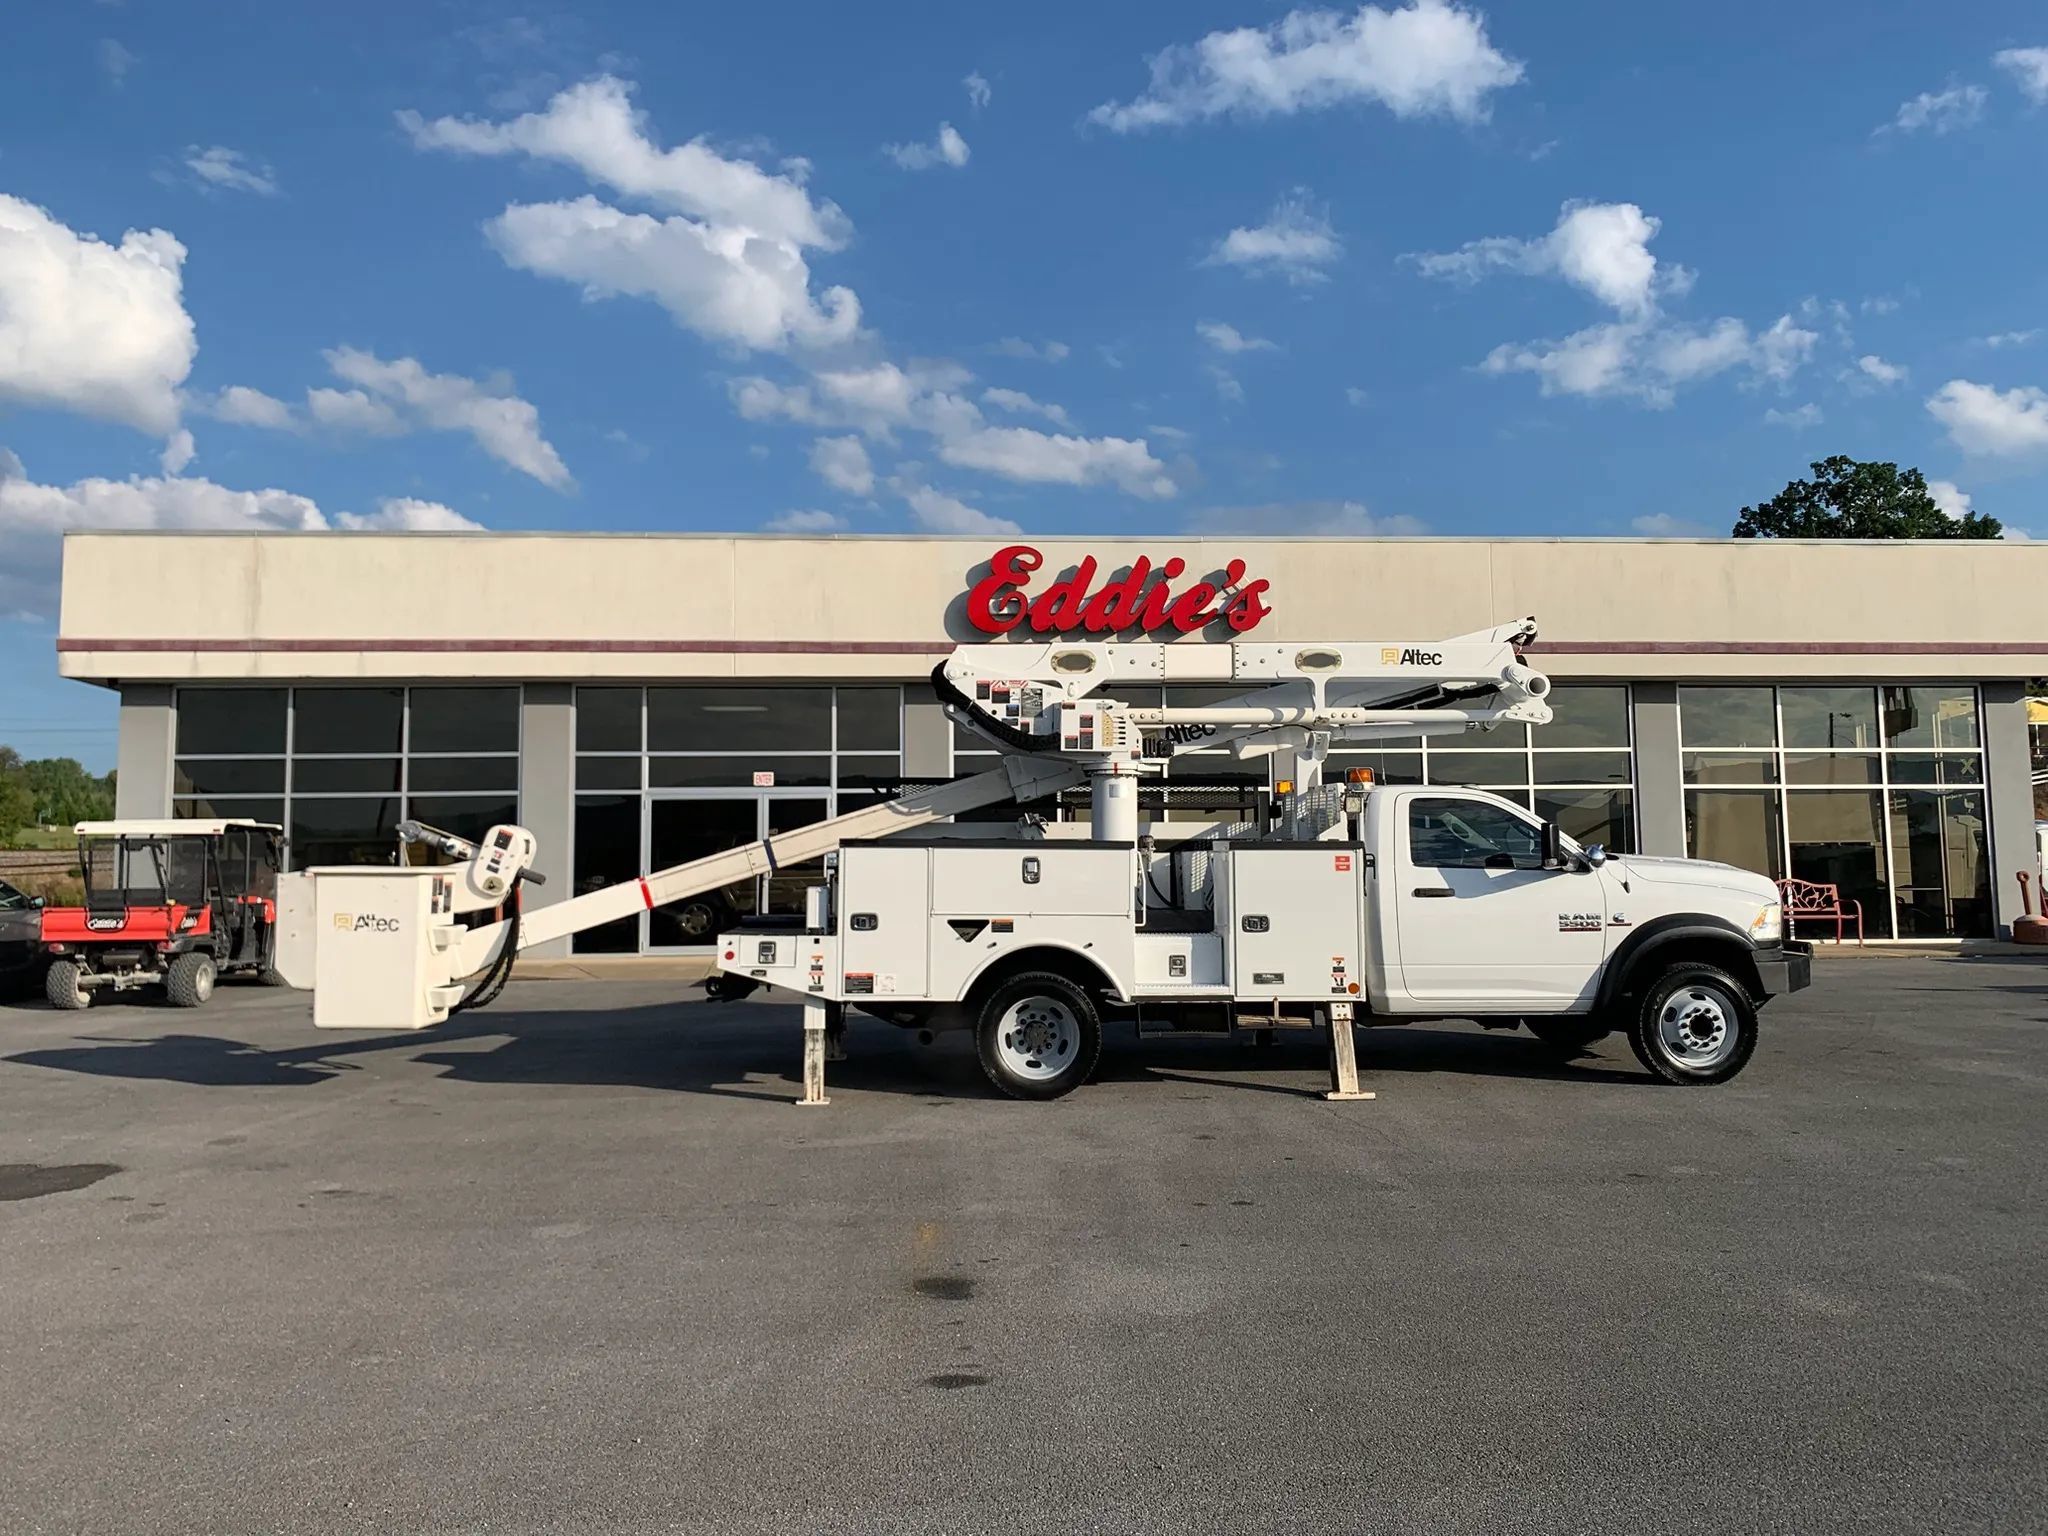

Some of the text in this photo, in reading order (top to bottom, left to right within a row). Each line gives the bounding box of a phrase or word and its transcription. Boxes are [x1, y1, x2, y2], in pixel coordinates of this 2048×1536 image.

[966, 545, 1273, 634] Eddie's
[1400, 648, 1442, 666] Altec
[353, 914, 399, 932] Altec
